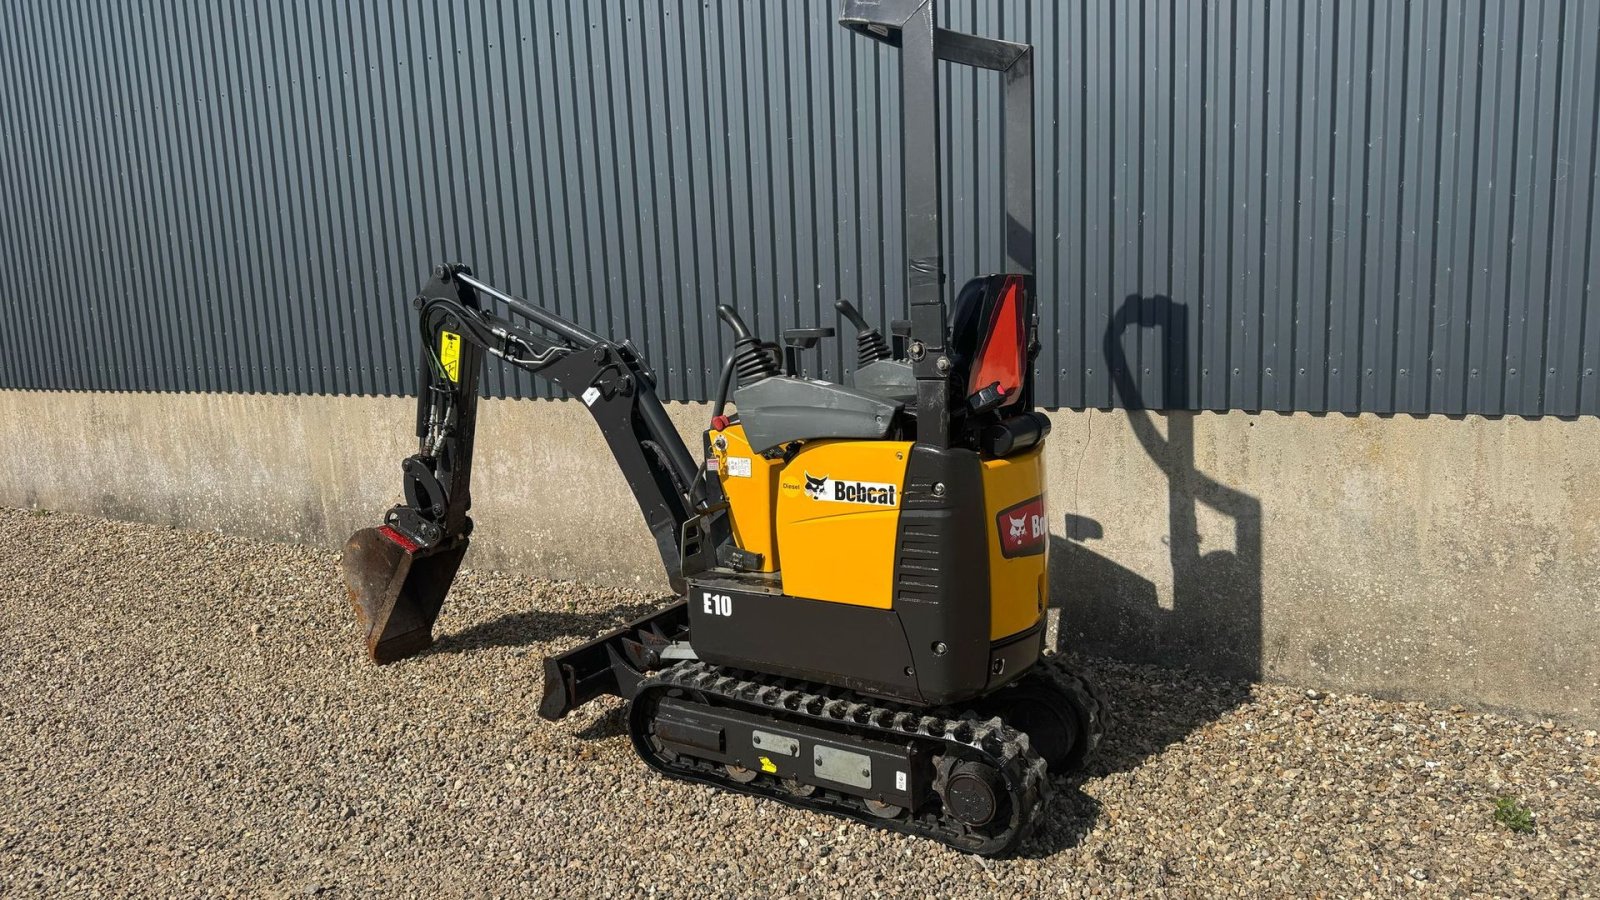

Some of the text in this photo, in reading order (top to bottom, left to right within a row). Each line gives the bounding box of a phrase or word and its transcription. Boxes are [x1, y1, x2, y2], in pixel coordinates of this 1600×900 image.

[782, 482, 800, 490] Diesel
[834, 480, 895, 506] Bobcat
[703, 592, 732, 617] E10
